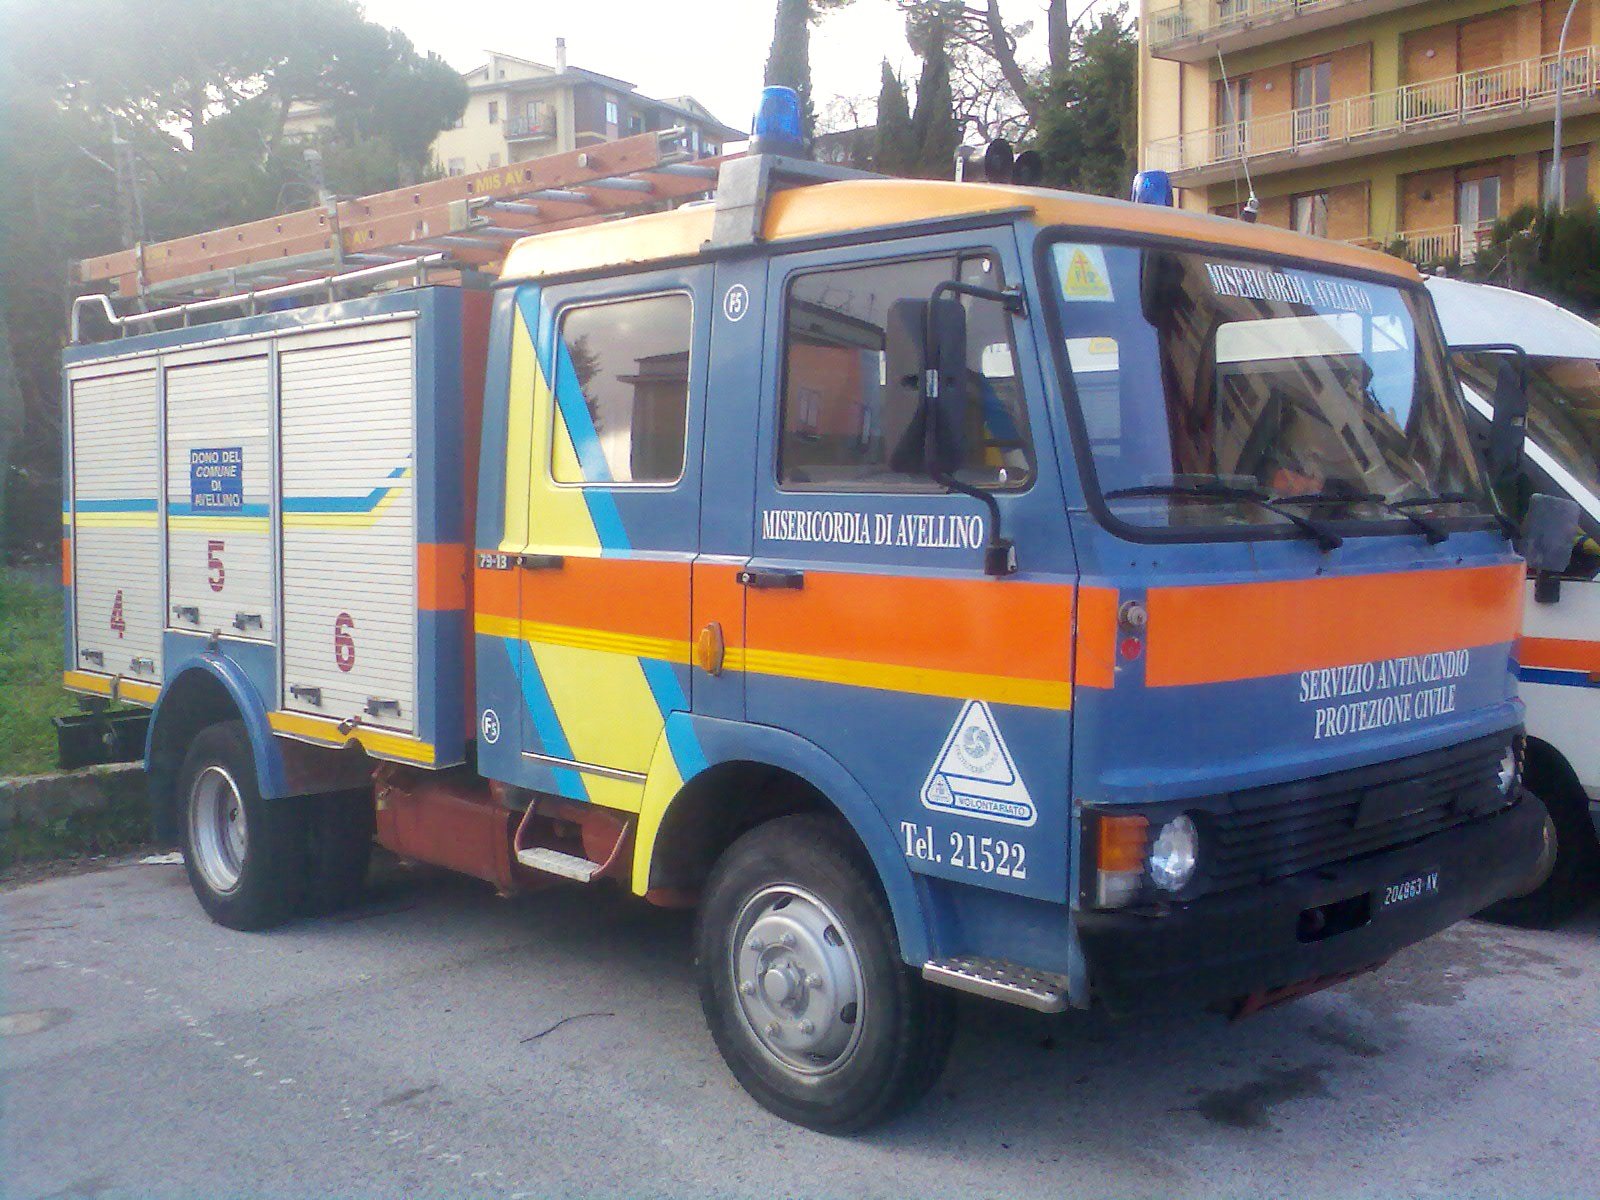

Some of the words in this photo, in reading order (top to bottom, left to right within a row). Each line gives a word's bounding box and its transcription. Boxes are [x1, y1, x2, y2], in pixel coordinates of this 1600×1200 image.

[1204, 262, 1315, 306] MISERICORDIA
[191, 451, 219, 464] DONO
[222, 451, 241, 463] DEL
[195, 465, 237, 478] COMUNE
[195, 493, 240, 507] AVELLINO
[211, 480, 222, 491] DI
[762, 509, 871, 545] MISERICORDIA
[874, 513, 894, 546] DI
[896, 513, 984, 549] AVELLINO
[207, 539, 225, 592] 5
[110, 589, 126, 639] 4
[334, 612, 355, 672] 6
[1299, 661, 1375, 703] SERVIZIO
[1376, 648, 1470, 690] ANTINCENDIO
[1314, 692, 1413, 740] PROTEZIONE
[1414, 684, 1457, 720] CIVILE
[957, 797, 1025, 816] VOLONTARIATO
[900, 821, 942, 863] Tel.
[949, 831, 1027, 880] 21522
